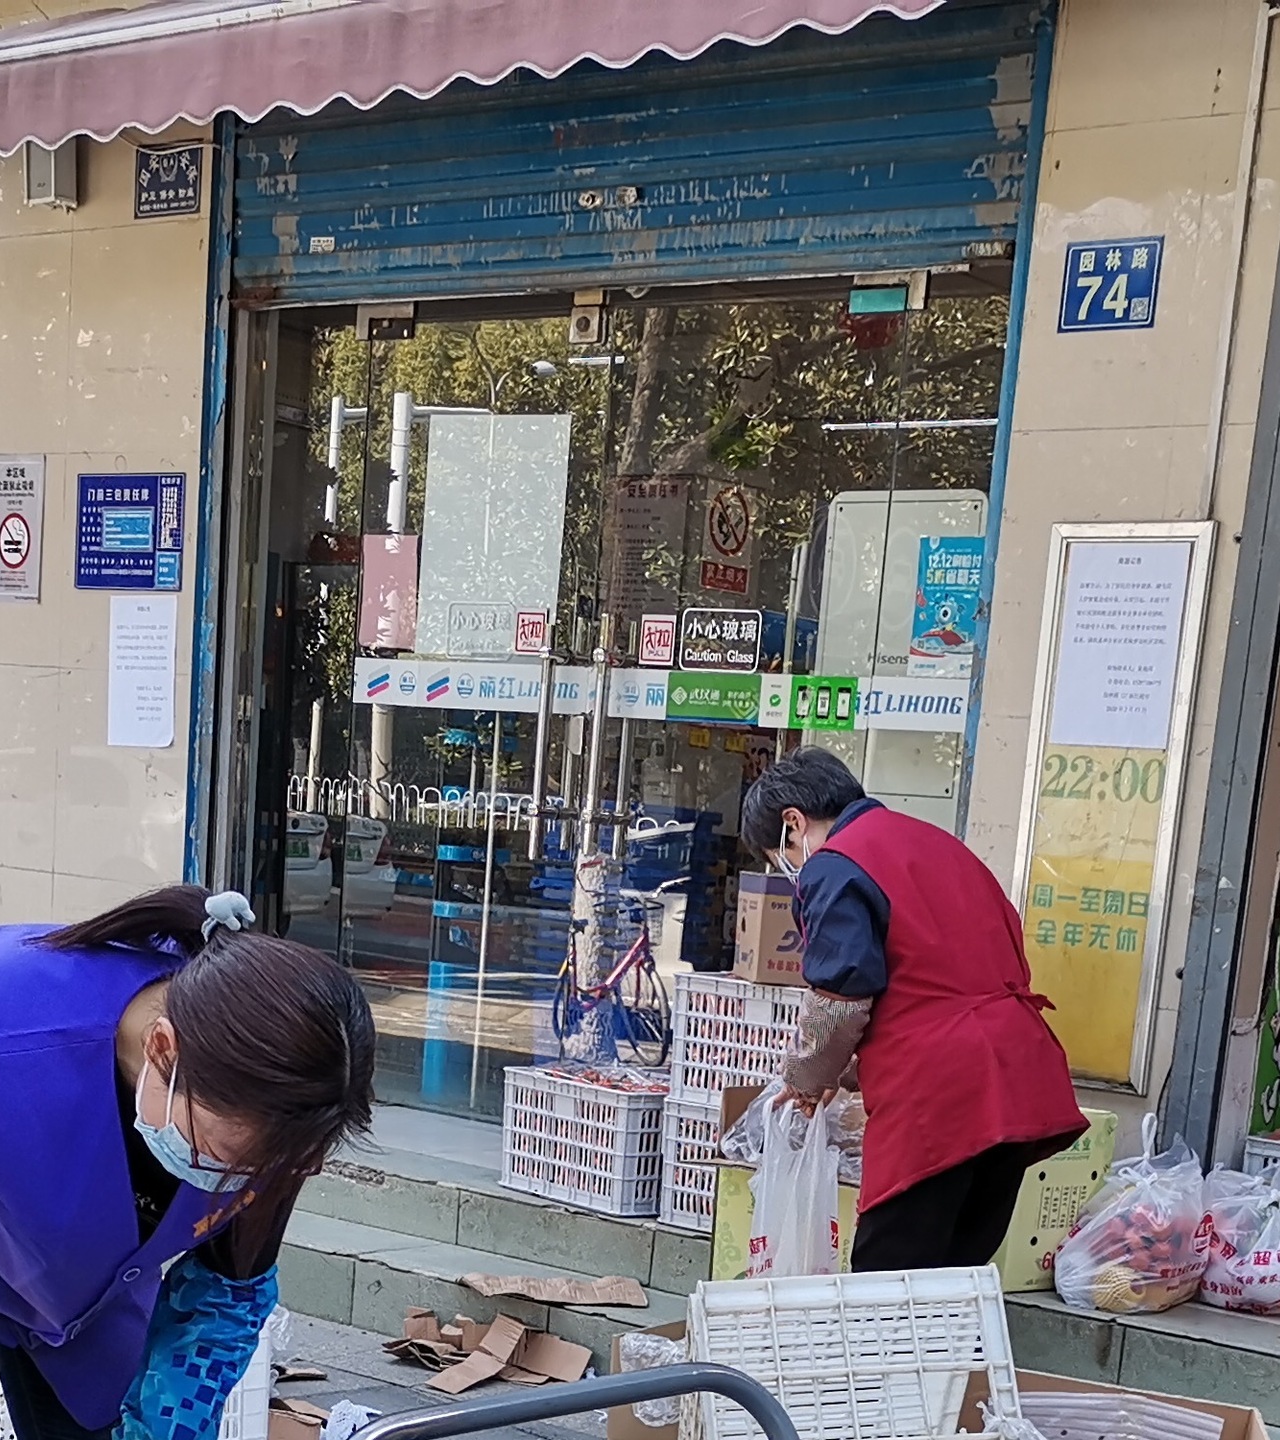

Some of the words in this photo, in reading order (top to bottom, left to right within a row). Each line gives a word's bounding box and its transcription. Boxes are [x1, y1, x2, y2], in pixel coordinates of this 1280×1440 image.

[1079, 247, 1149, 272] 园林路
[1077, 274, 1129, 321] 74
[5, 467, 26, 478] 本区域
[686, 617, 758, 641] 小心玻璃
[685, 648, 722, 663] Caution
[726, 649, 754, 664] Glass
[867, 652, 909, 665] Hisens
[479, 676, 516, 699] 丽红
[1041, 754, 1166, 804] 22:00
[1032, 884, 1150, 918] 周一至周日
[1036, 919, 1138, 952] 全年无休
